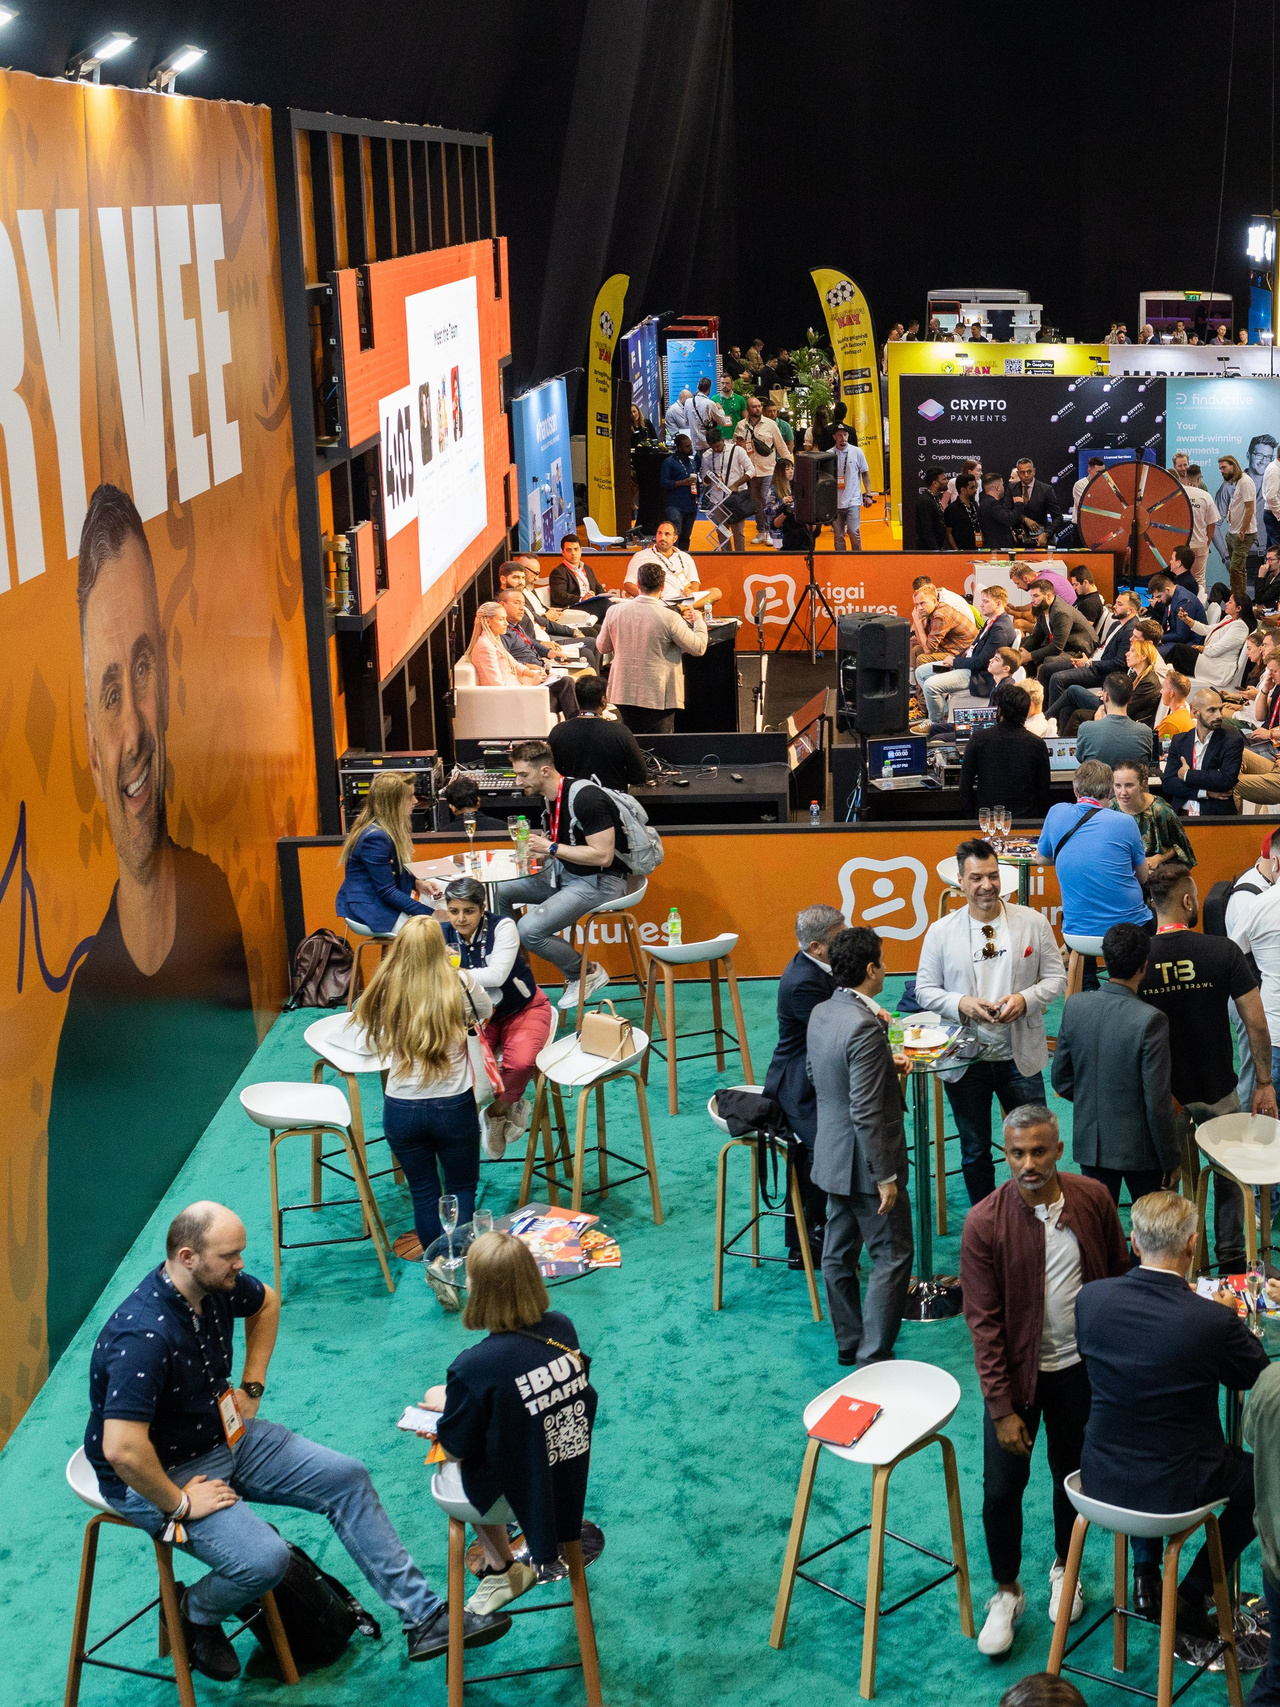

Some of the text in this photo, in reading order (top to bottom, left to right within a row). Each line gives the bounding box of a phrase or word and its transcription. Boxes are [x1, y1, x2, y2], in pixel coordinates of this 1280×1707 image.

[97, 203, 242, 521] VEE
[950, 399, 1007, 411] CRYPTO
[1176, 421, 1198, 430] Your
[1176, 434, 1242, 445] award-winning
[386, 405, 414, 510] 4:03
[951, 454, 981, 462] Processing
[553, 920, 670, 945] ntures
[1143, 982, 1214, 995] TRADERS BRAWL
[527, 1348, 582, 1395] BUY
[515, 1374, 533, 1400] WE
